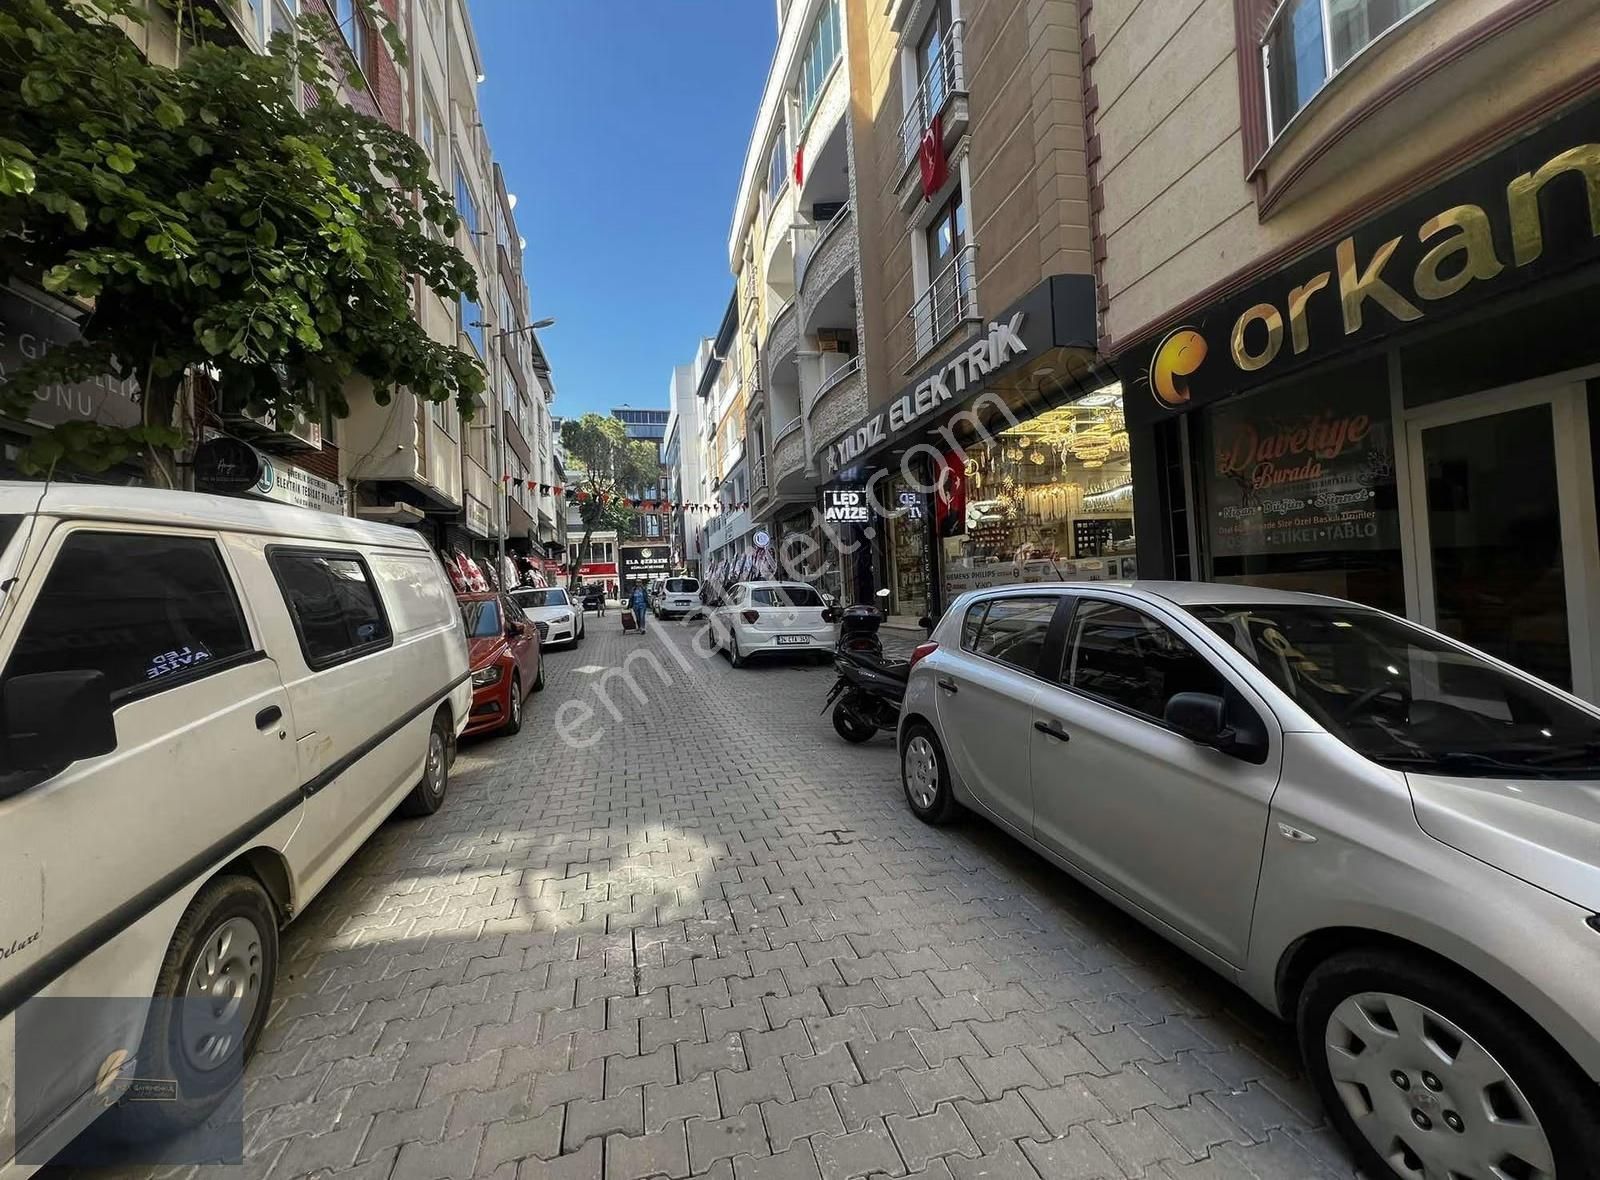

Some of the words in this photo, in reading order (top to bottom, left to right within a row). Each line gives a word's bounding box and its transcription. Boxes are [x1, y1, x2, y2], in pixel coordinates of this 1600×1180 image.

[1230, 143, 1600, 371] orkan
[837, 412, 887, 465] YILDIZ
[889, 311, 1028, 432] ELEKTRİK
[1252, 457, 1322, 490] Burada
[826, 504, 868, 520] AVİZE
[832, 493, 860, 506] LED
[1327, 523, 1377, 540] TABLO
